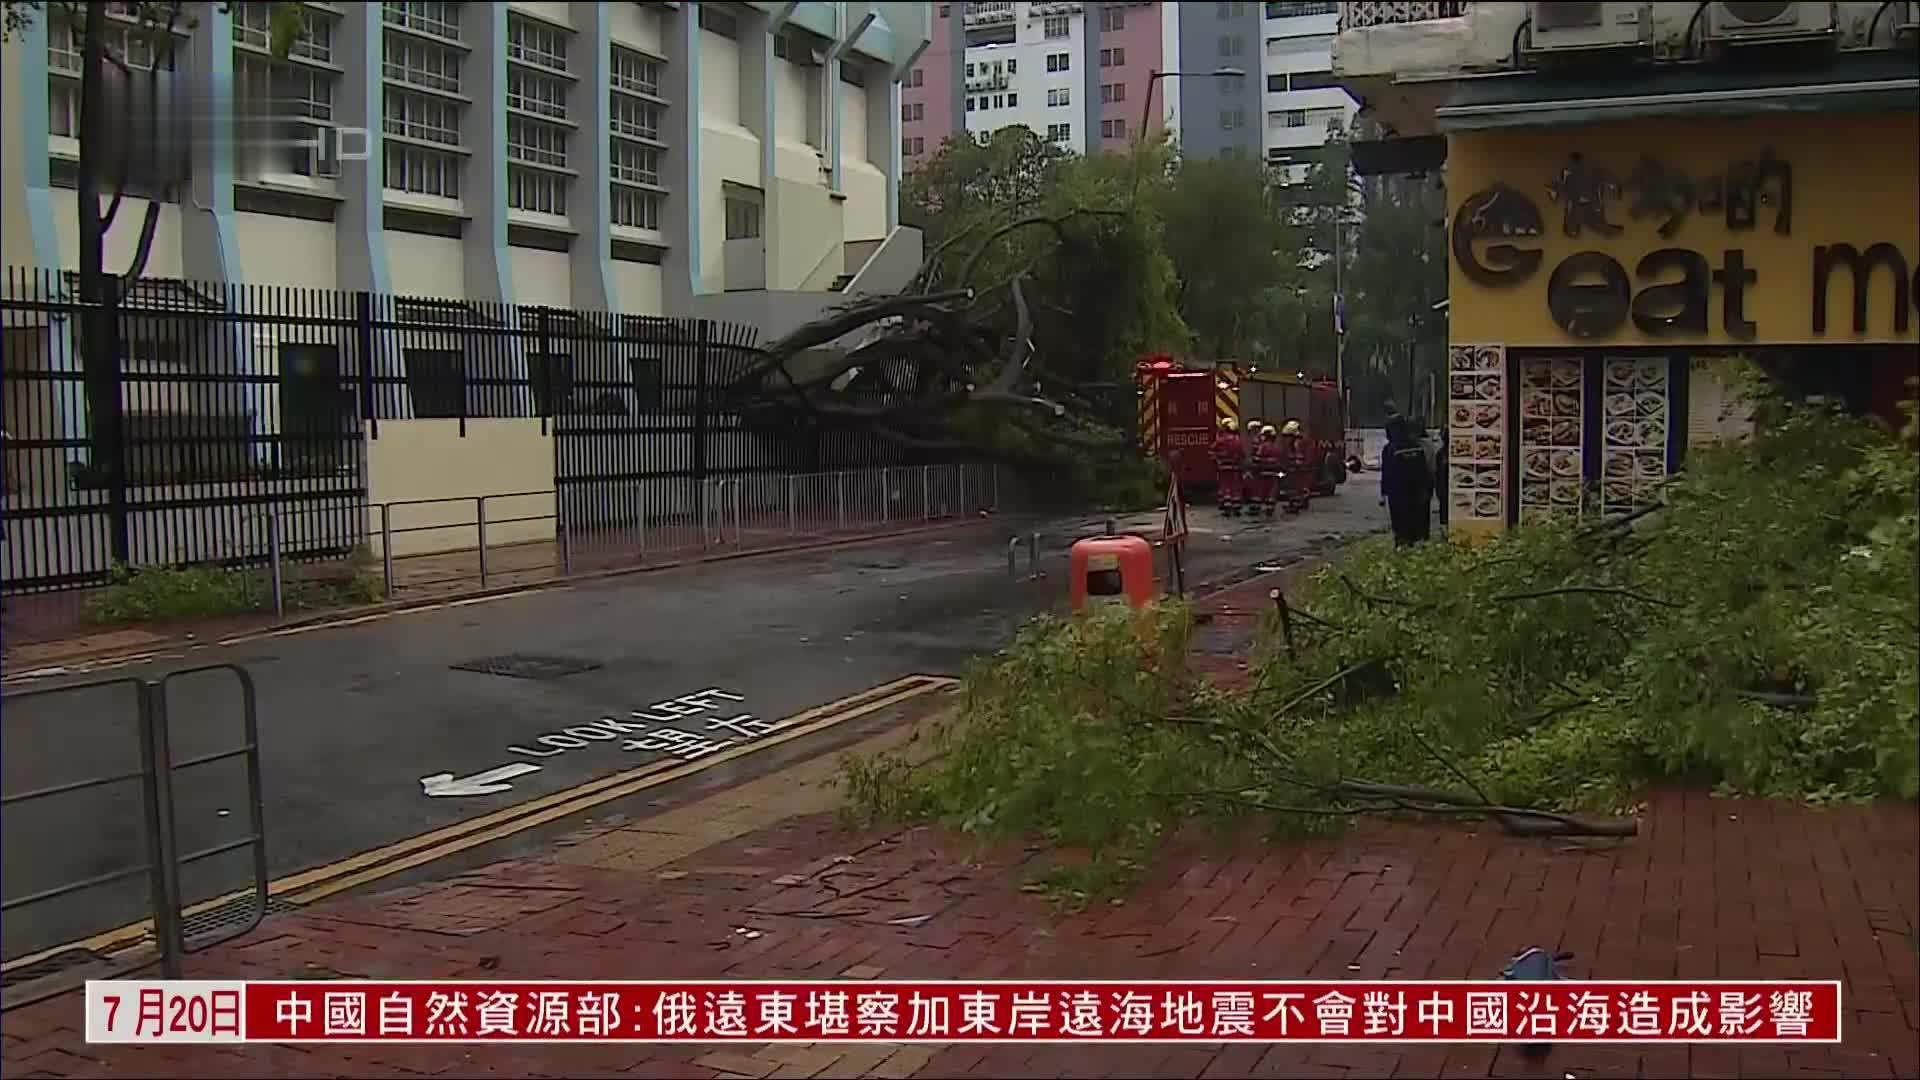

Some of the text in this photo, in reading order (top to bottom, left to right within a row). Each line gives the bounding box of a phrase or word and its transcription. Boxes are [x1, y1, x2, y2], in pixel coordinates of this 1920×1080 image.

[1547, 241, 1919, 338] eat m
[1167, 432, 1209, 447] RESCUE
[506, 687, 745, 757] LOOK LEFT
[622, 714, 773, 760] 望左
